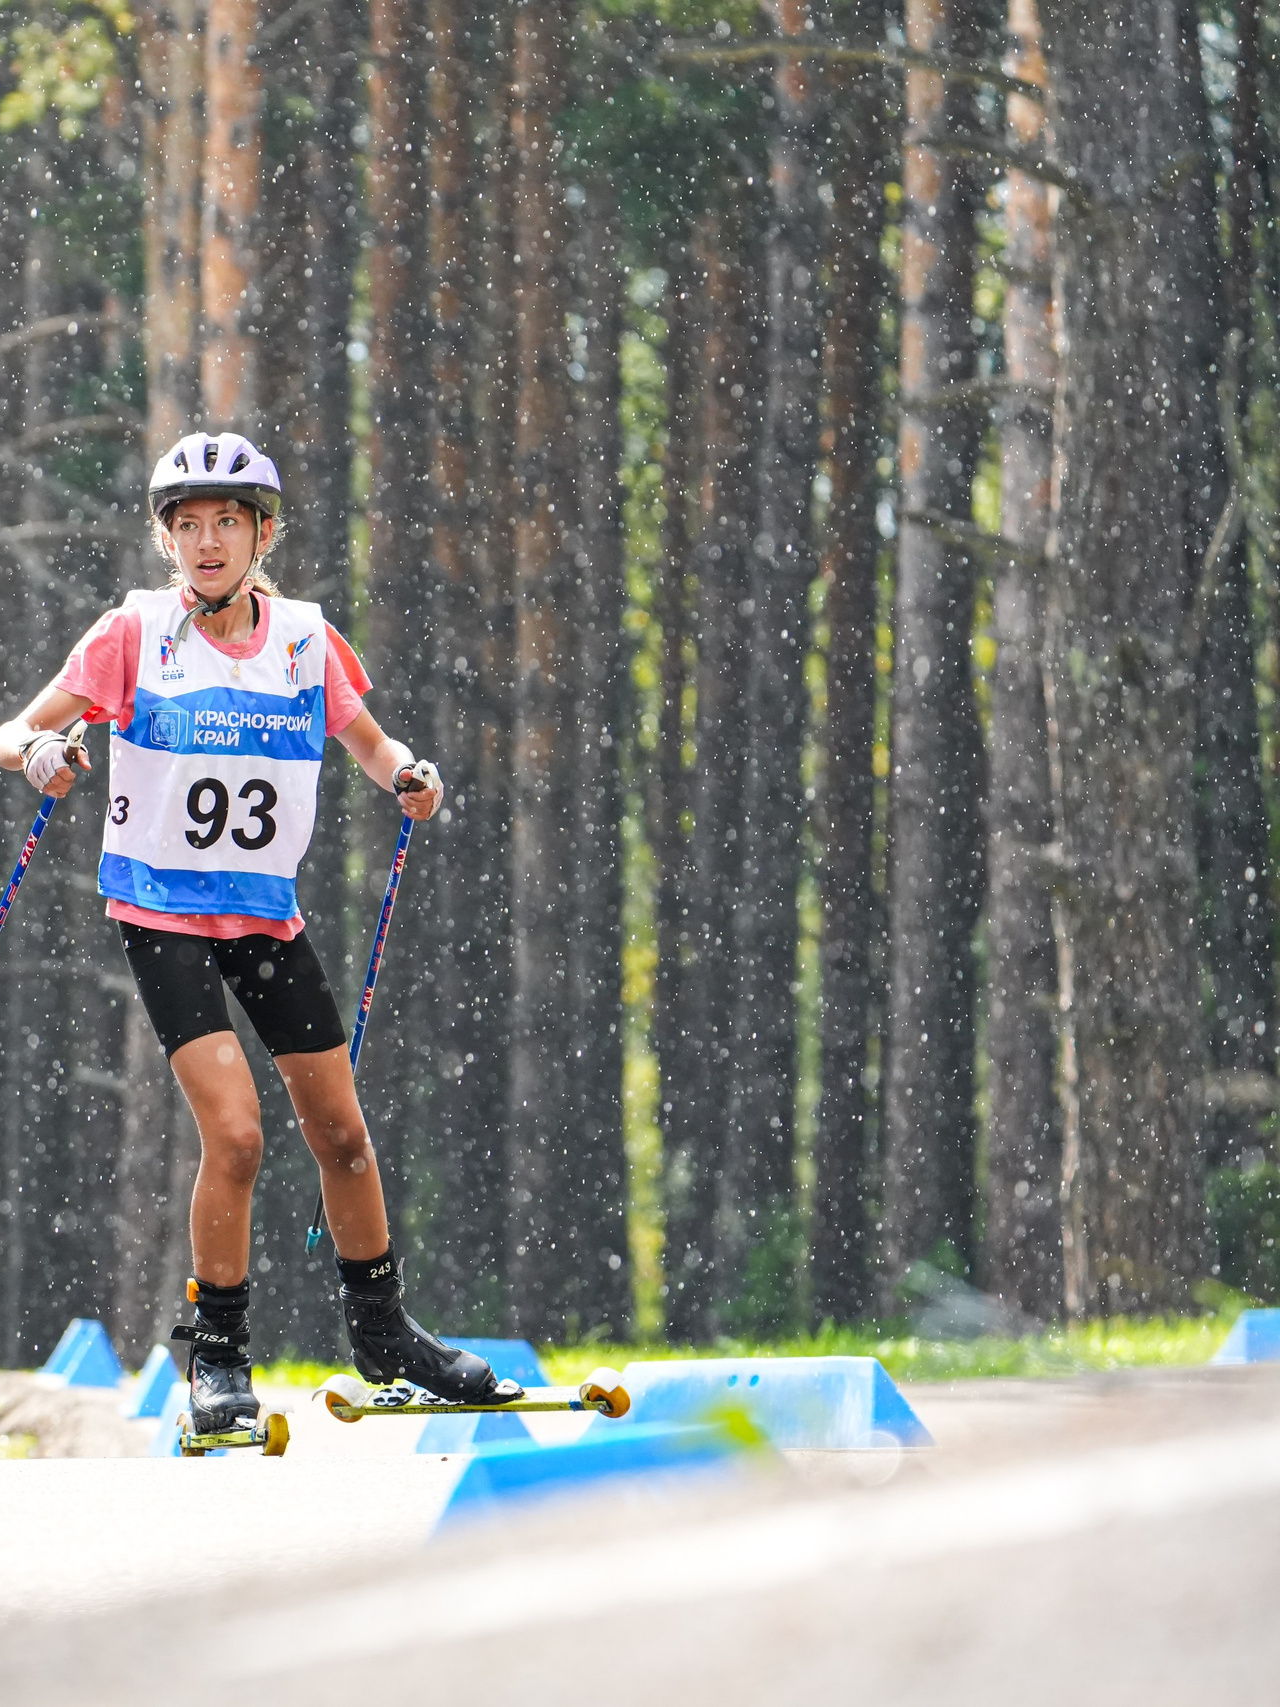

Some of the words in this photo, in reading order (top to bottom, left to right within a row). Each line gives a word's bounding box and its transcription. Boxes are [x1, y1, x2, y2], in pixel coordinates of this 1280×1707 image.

[193, 728, 240, 747] КРАЙ
[108, 795, 130, 826] 3
[185, 777, 278, 851] 93
[370, 1261, 391, 1279] 243
[194, 1331, 229, 1344] TISA
[200, 1369, 214, 1386] TISA
